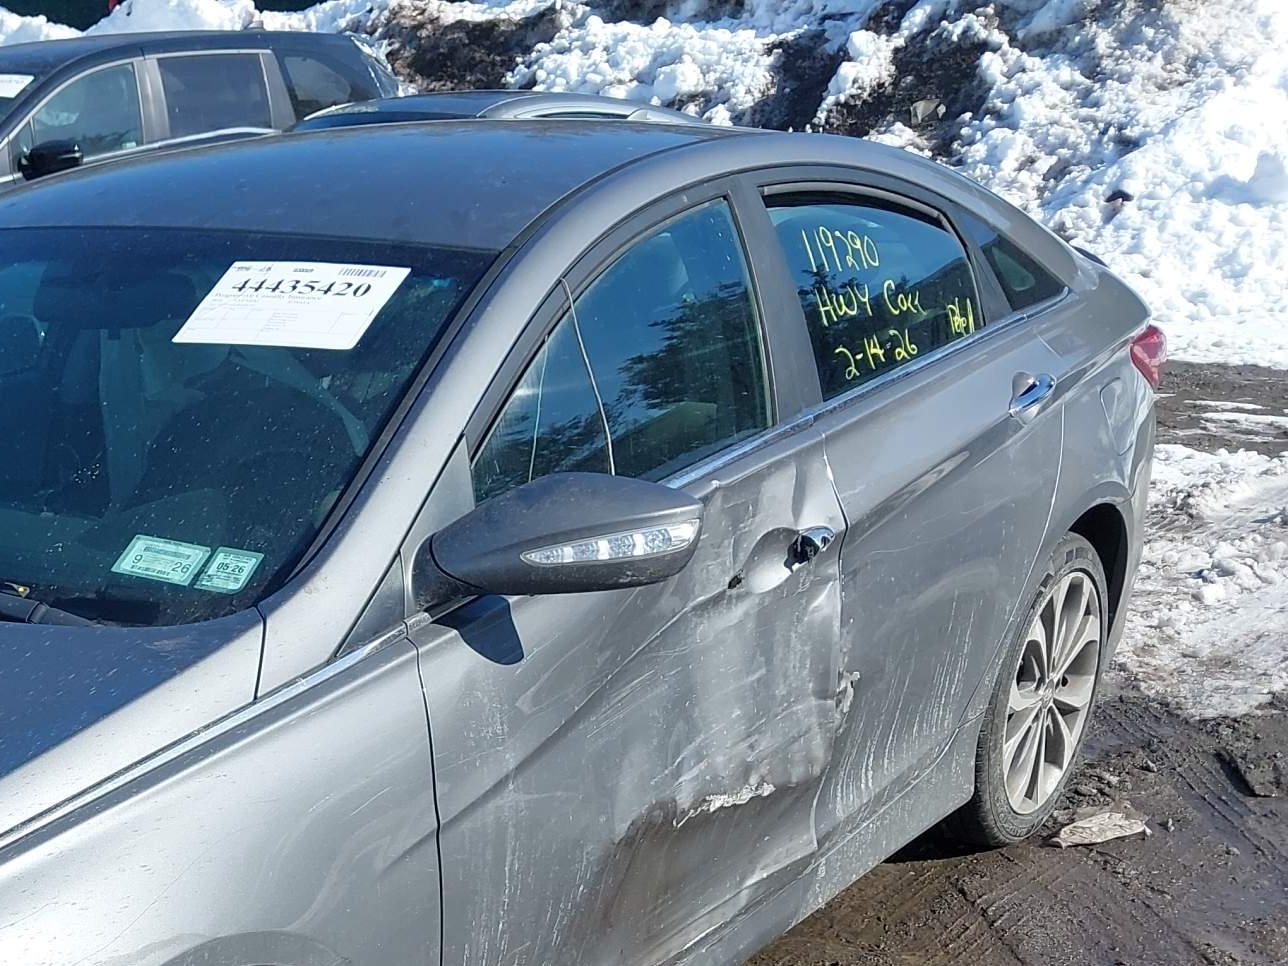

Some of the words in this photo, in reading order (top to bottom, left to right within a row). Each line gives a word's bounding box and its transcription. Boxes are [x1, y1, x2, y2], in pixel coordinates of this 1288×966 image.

[802, 226, 880, 272] 119290
[231, 277, 372, 298] 44435420
[834, 328, 919, 381] 2-14-26
[132, 554, 143, 565] 9
[171, 562, 192, 574] 26
